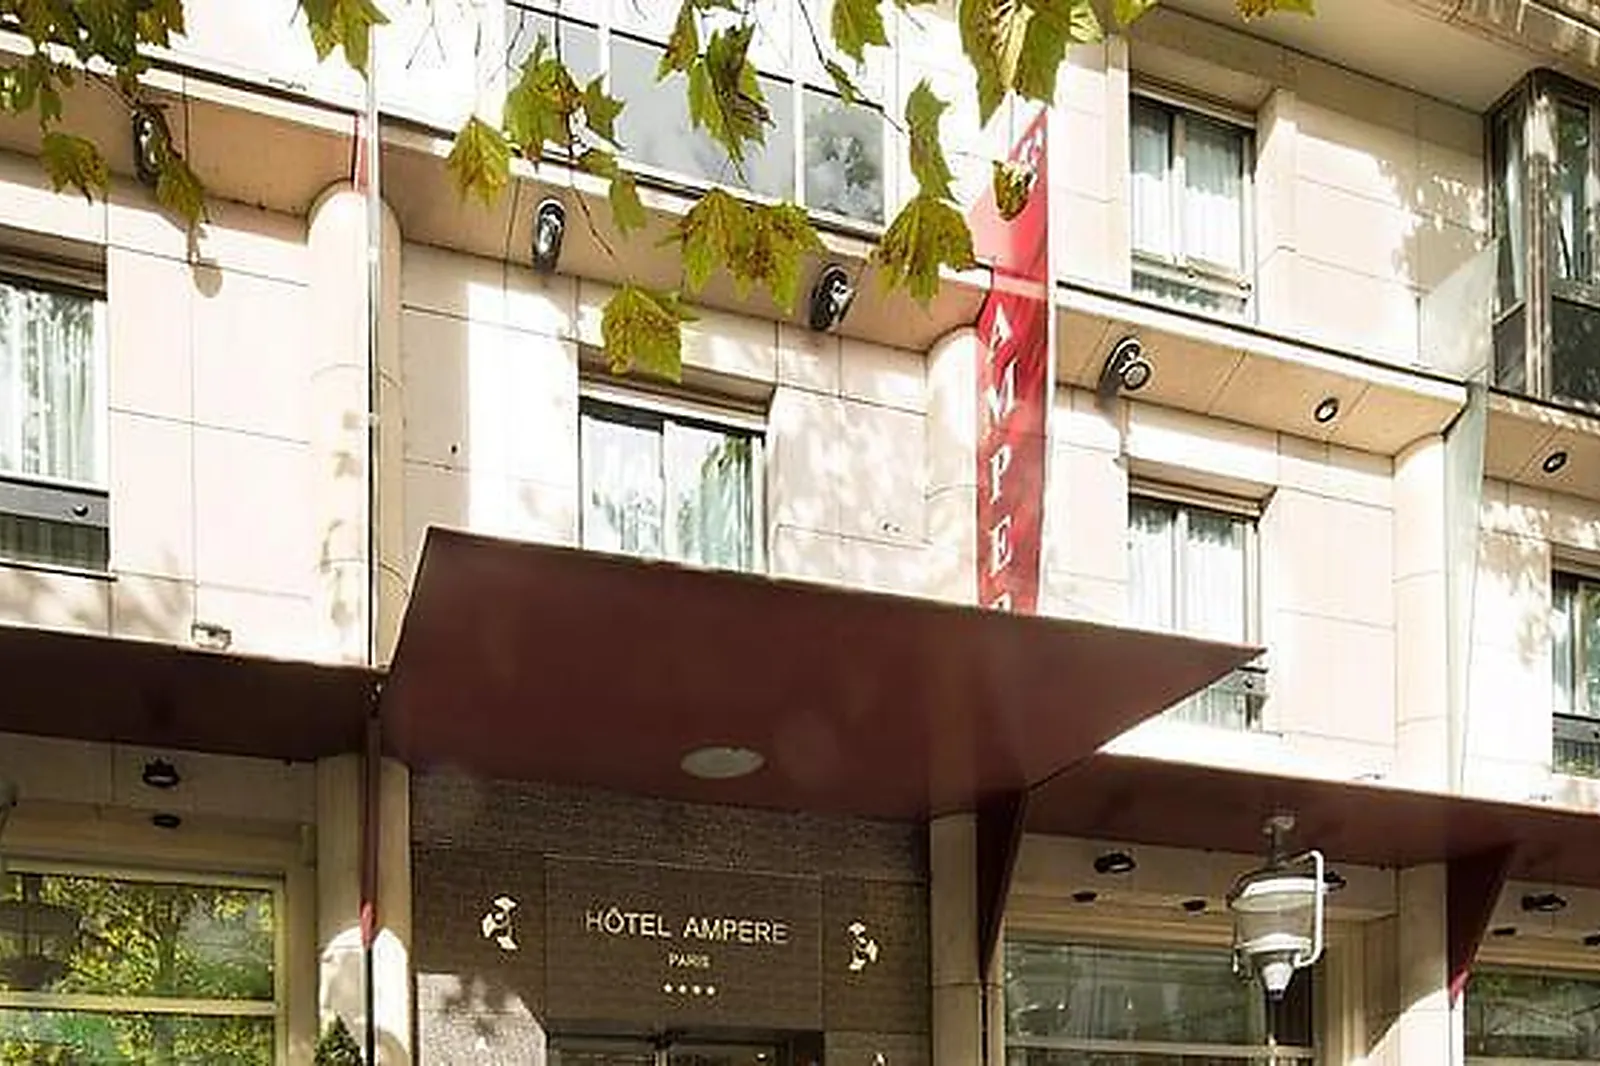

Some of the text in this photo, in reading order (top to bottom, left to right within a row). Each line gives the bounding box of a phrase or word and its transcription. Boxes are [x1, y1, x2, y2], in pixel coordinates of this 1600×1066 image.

[585, 907, 789, 944] HÔTEL AMPERE
[668, 953, 710, 969] PARIS
